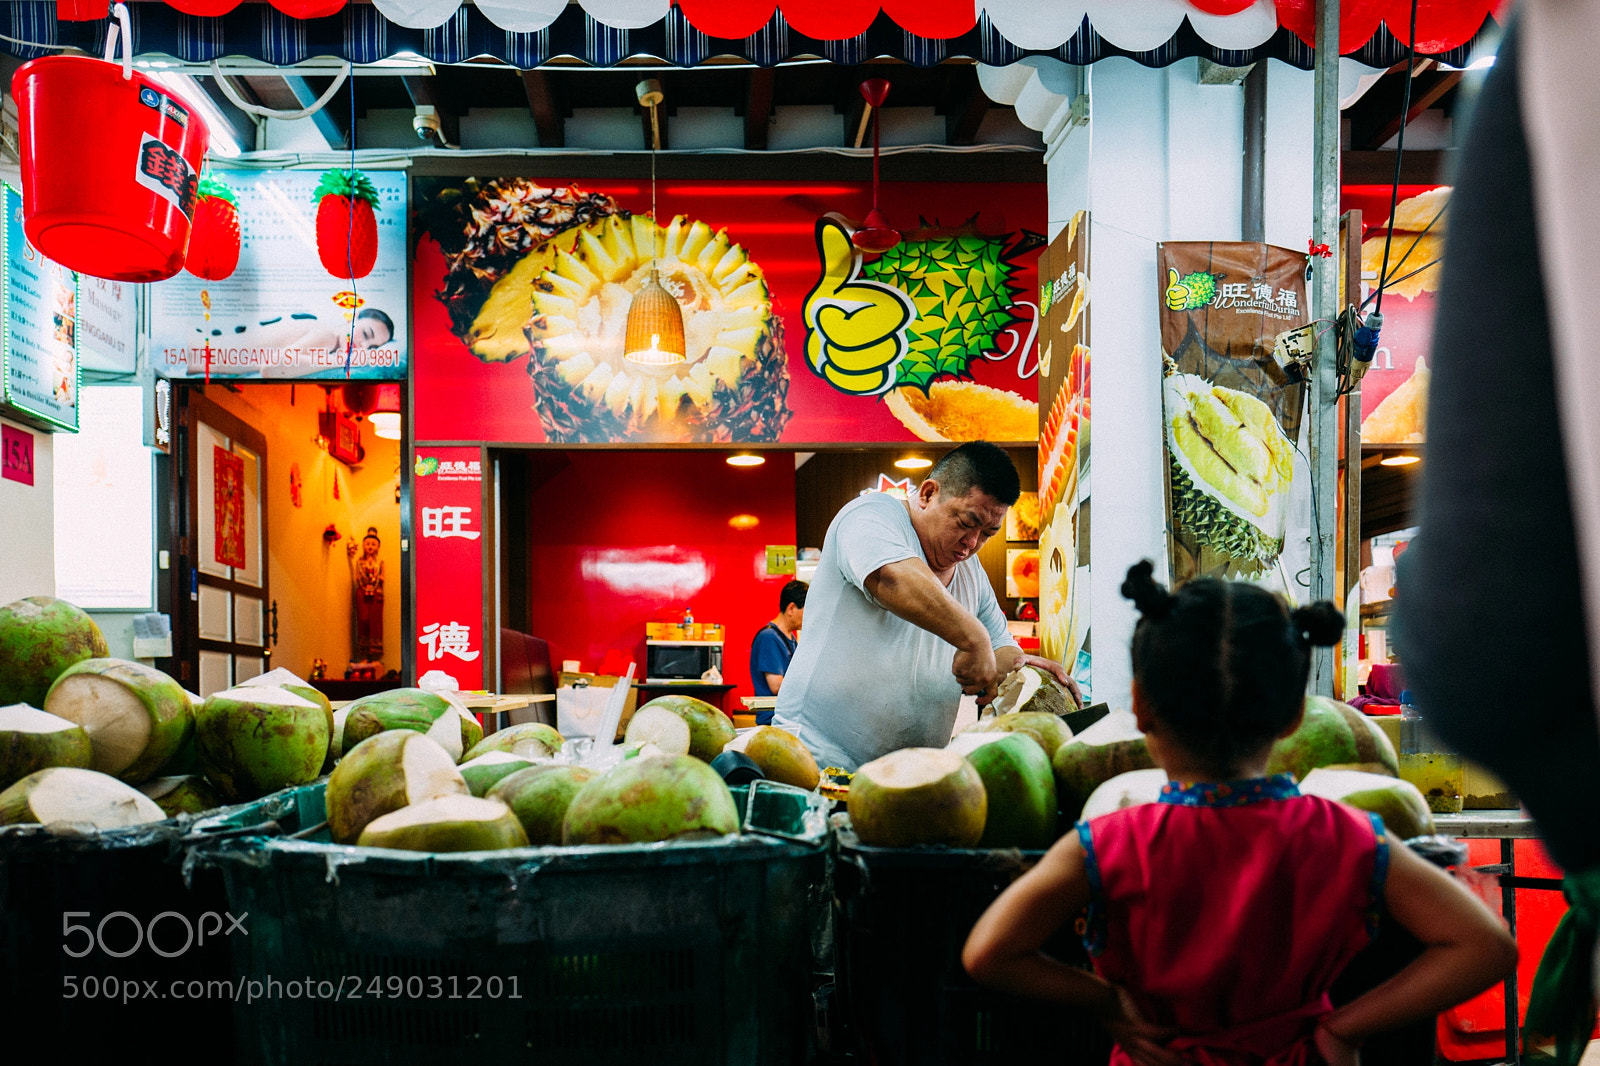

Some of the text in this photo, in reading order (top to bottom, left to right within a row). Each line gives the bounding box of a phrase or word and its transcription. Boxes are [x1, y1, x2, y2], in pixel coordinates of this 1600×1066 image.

[1222, 283, 1297, 308] 旺德福
[80, 319, 116, 348] ENGGANU
[163, 348, 188, 365] 15A
[284, 348, 301, 365] ST
[309, 348, 333, 365] TEL
[369, 349, 399, 366] 9891
[4, 437, 32, 474] 15A
